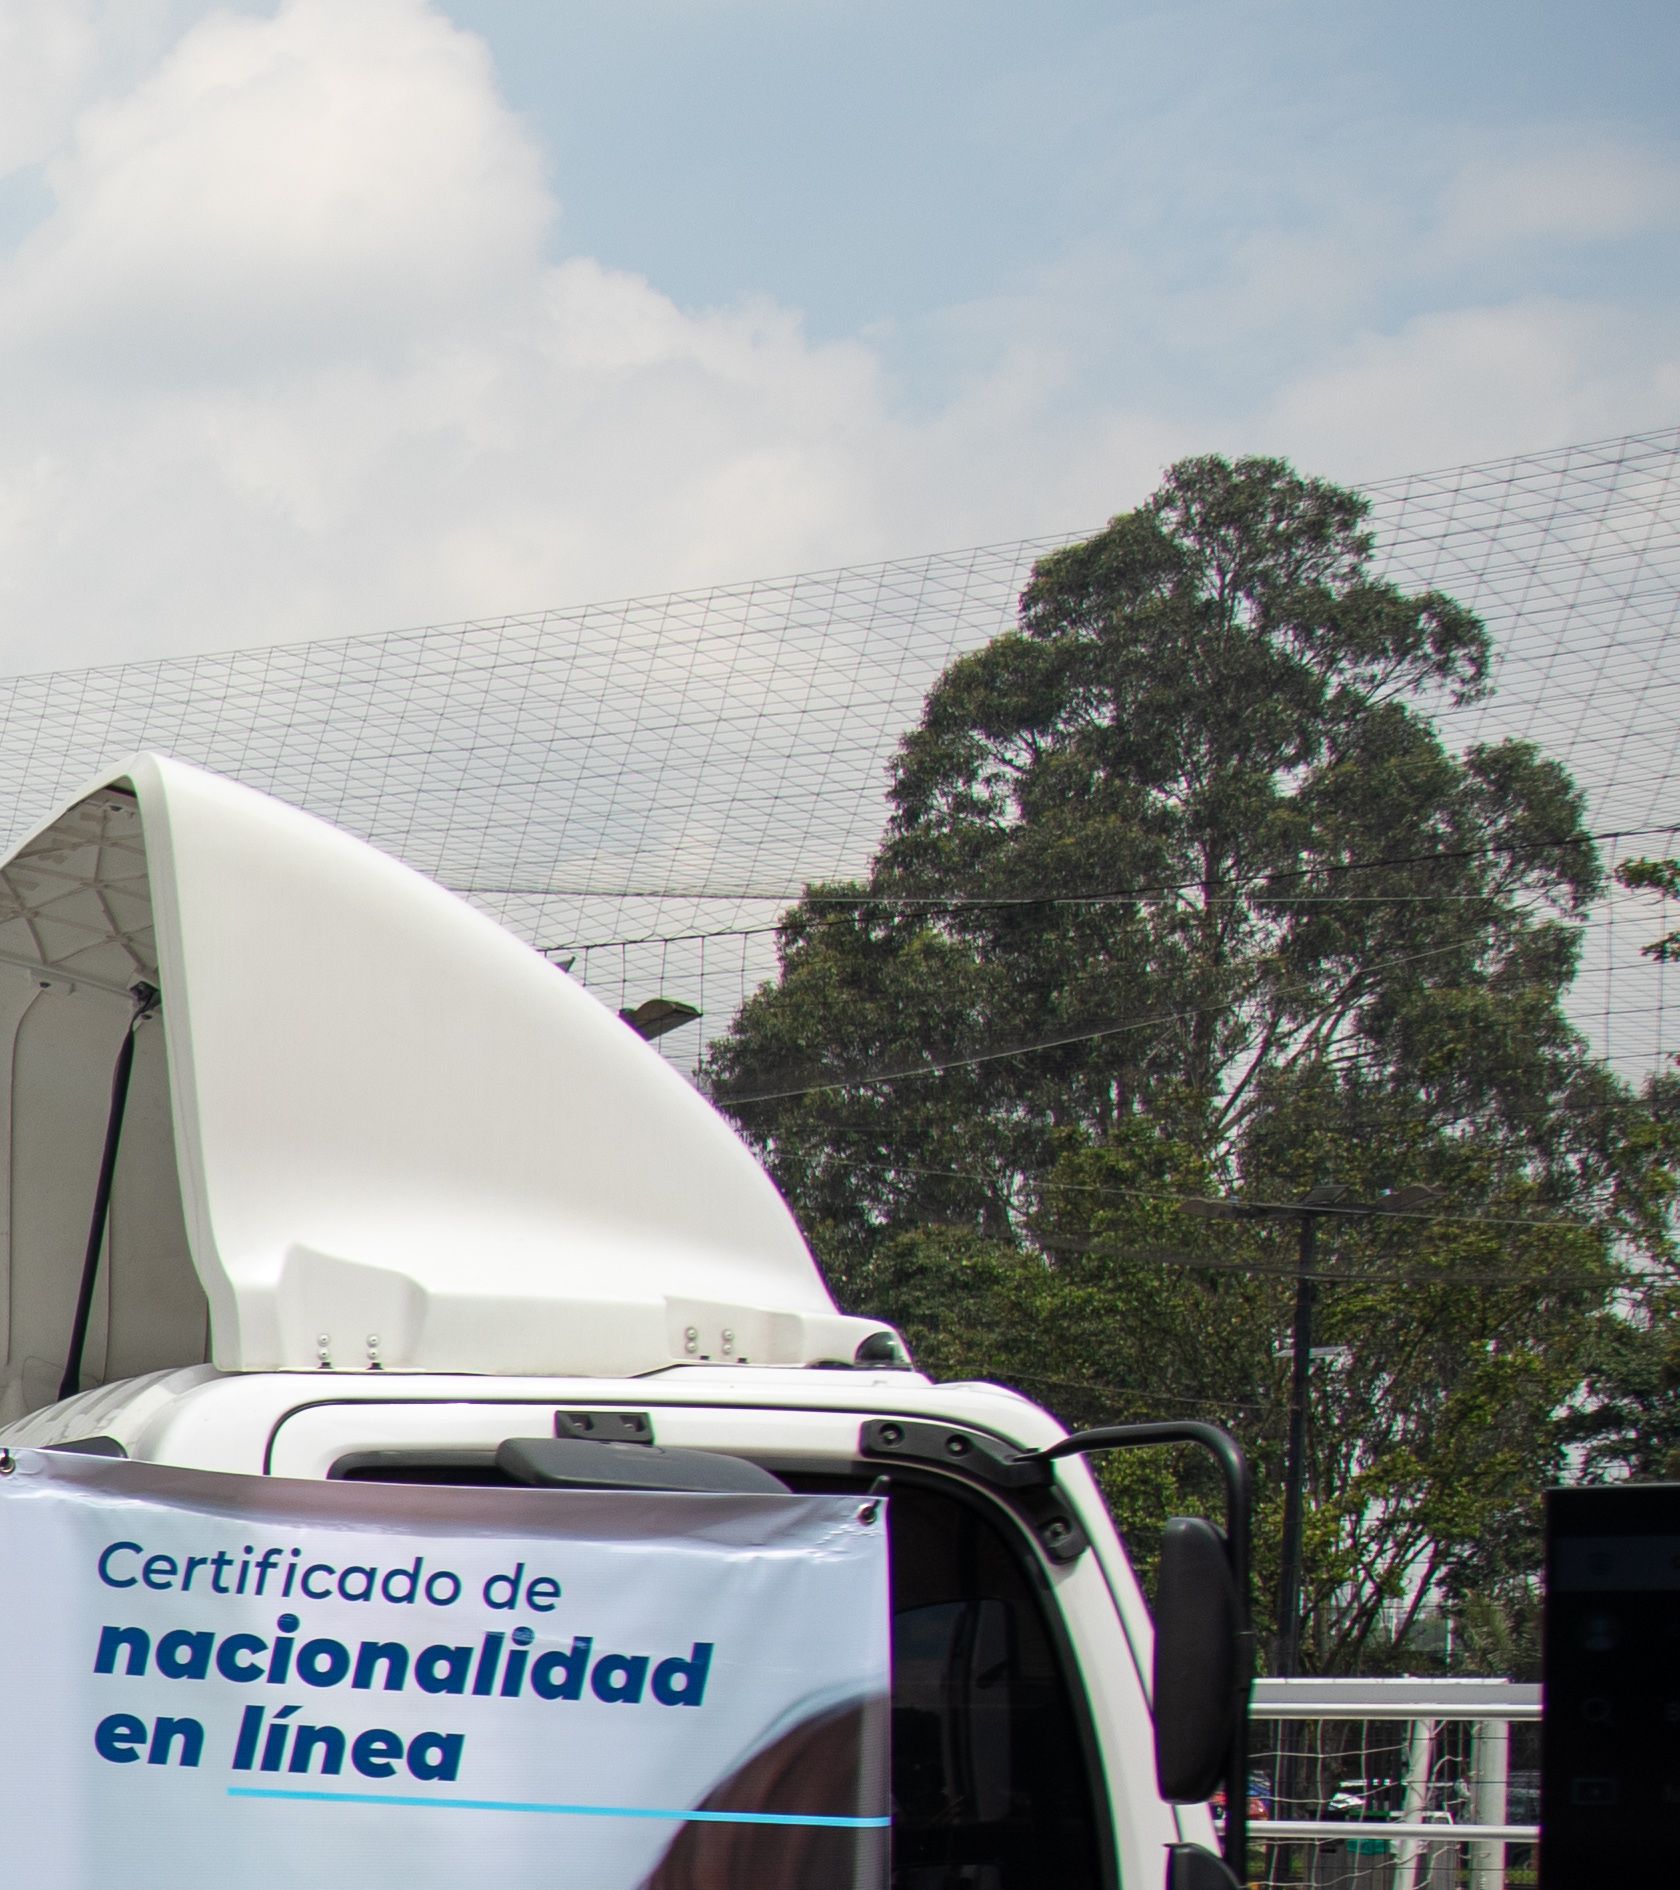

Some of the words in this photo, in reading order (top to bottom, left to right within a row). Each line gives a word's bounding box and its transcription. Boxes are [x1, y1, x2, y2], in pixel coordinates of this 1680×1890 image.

[98, 1540, 462, 1604] Certificado
[482, 1561, 562, 1614] de
[93, 1613, 715, 1707] nacionalidad
[93, 1711, 205, 1769] en
[230, 1705, 465, 1783] línea
